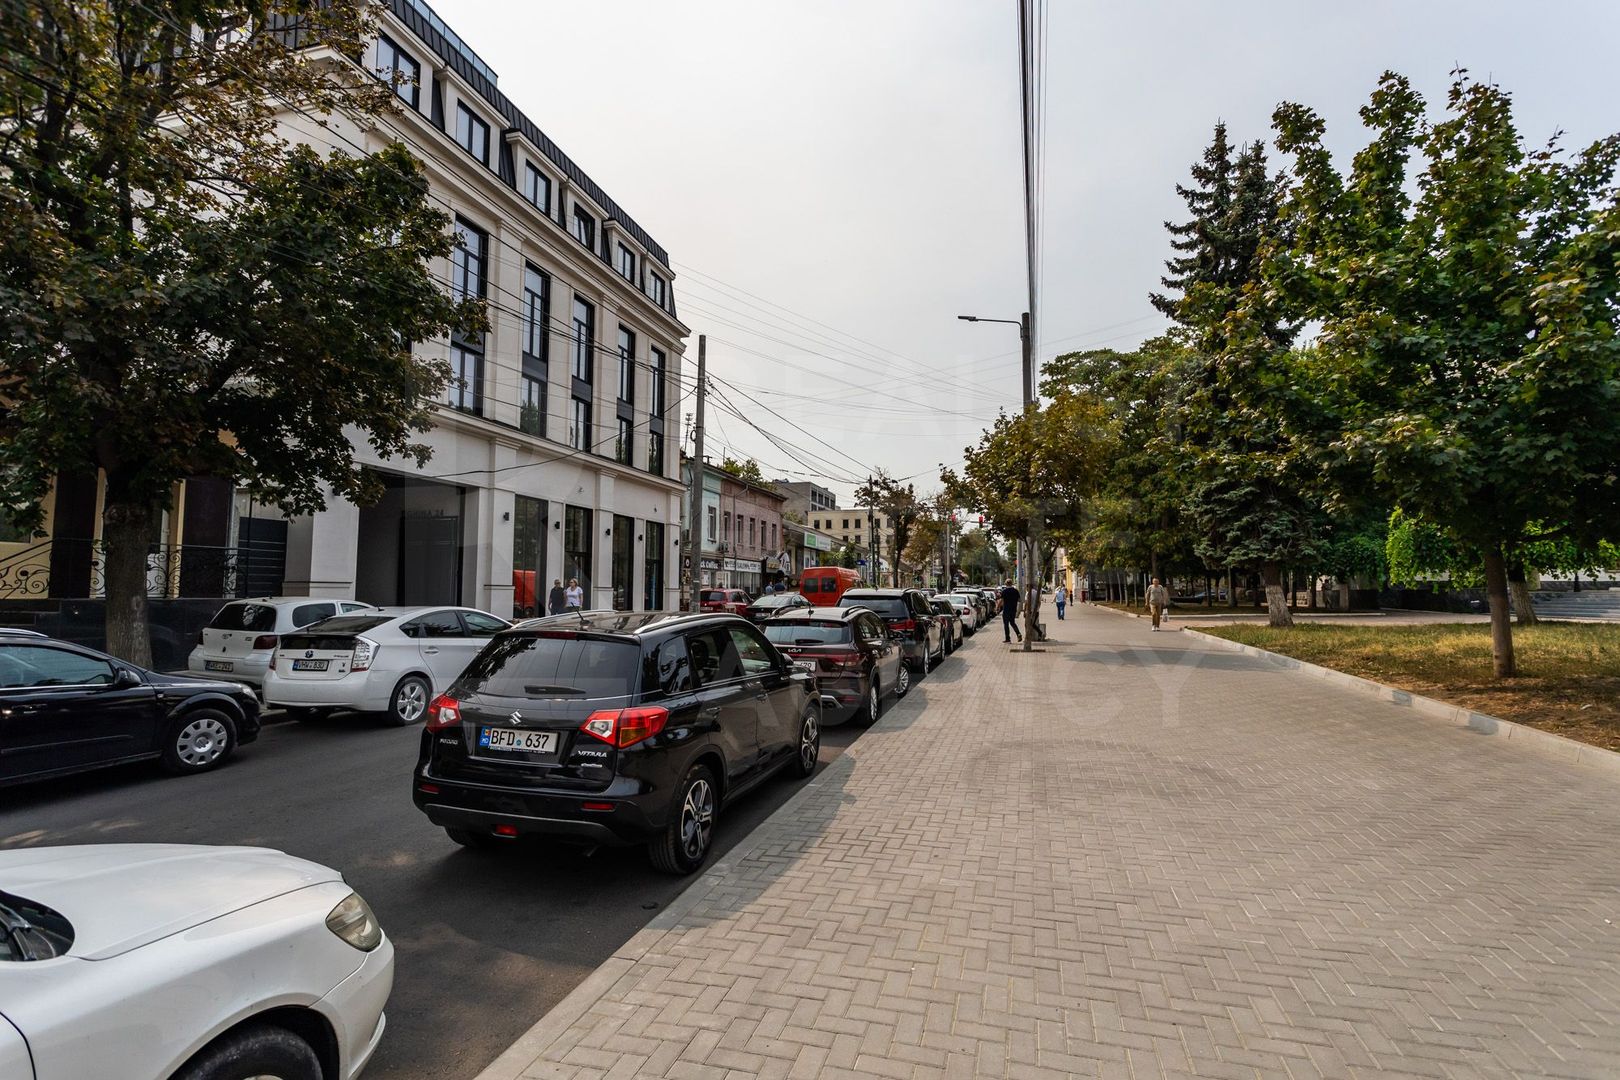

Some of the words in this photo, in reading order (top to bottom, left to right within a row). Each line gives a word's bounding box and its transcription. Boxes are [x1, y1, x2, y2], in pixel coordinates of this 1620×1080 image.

[491, 730, 516, 746] BFD
[525, 733, 550, 749] 637
[577, 750, 607, 758] VITARA
